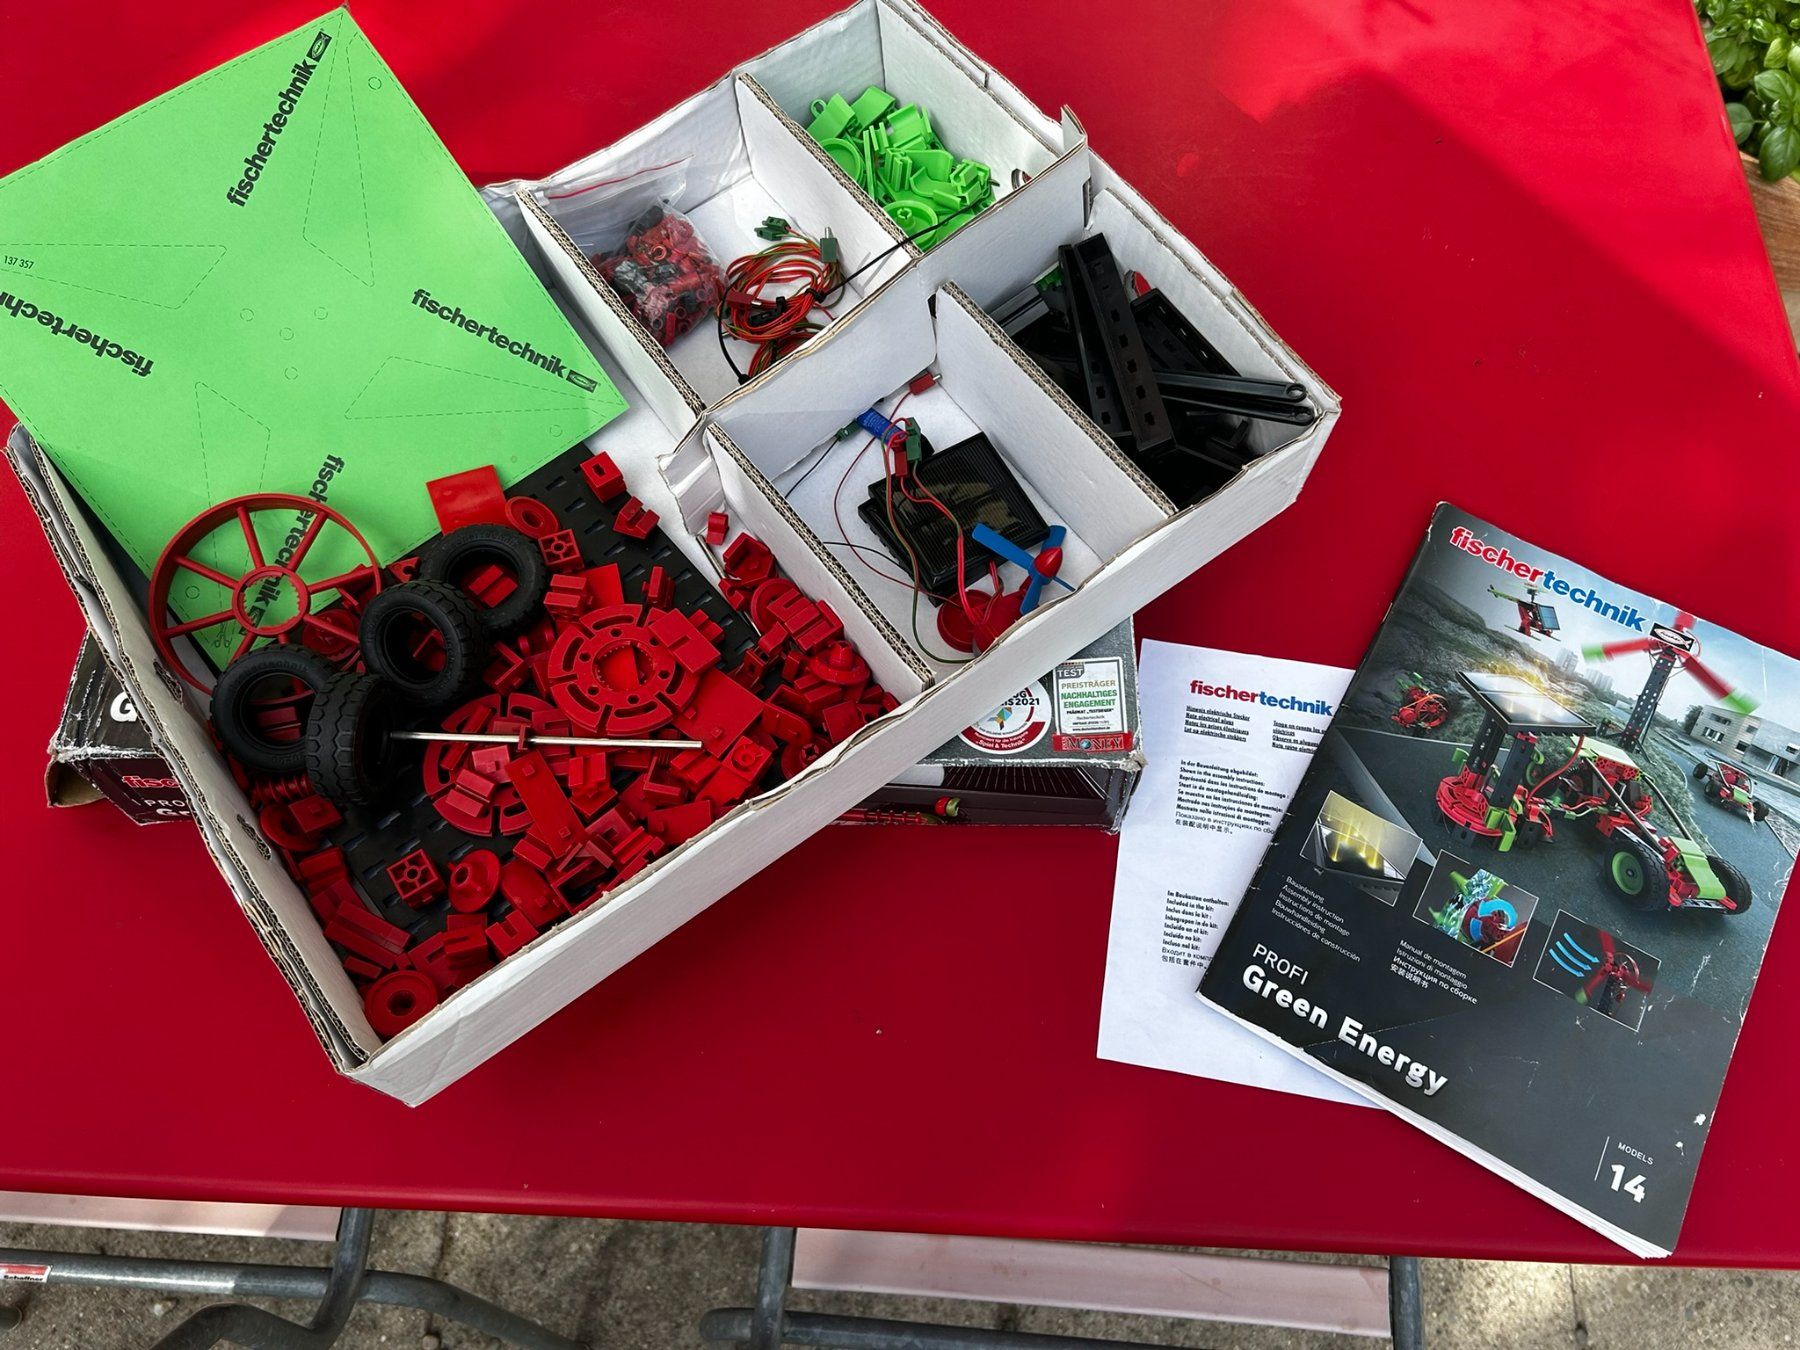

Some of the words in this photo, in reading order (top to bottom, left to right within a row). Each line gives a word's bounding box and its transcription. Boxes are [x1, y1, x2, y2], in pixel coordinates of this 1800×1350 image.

[226, 59, 317, 207] fischertechnik
[4, 256, 18, 266] 137
[19, 259, 34, 269] 357
[411, 288, 568, 379] fischertechnik
[1449, 525, 1648, 633] fischertechnik
[1056, 667, 1084, 678] TEST
[1061, 679, 1116, 690] PREISTRÄGER
[1015, 697, 1039, 705] 2021
[1060, 689, 1118, 700] NACHHALTIGES
[1063, 698, 1116, 709] ENGAGEMENT
[1190, 680, 1333, 717] fischertechnik
[1282, 883, 1312, 905] Assembly
[1312, 901, 1344, 923] instruction
[1312, 930, 1321, 939] de
[1252, 943, 1309, 985] PROFI
[1397, 947, 1426, 967] Istruzioni
[1426, 963, 1433, 971] di
[1433, 968, 1467, 990] montaggio
[1400, 939, 1423, 955] Manual
[1423, 952, 1432, 961] de
[1432, 957, 1467, 980] montagem
[1393, 955, 1438, 984] Инструкция
[1439, 980, 1449, 989] по
[1449, 985, 1479, 1006] сборке
[1242, 964, 1328, 1029] Green
[1338, 1016, 1448, 1096] Energy
[1617, 1141, 1654, 1166] MODELS
[1610, 1164, 1648, 1204] 14
